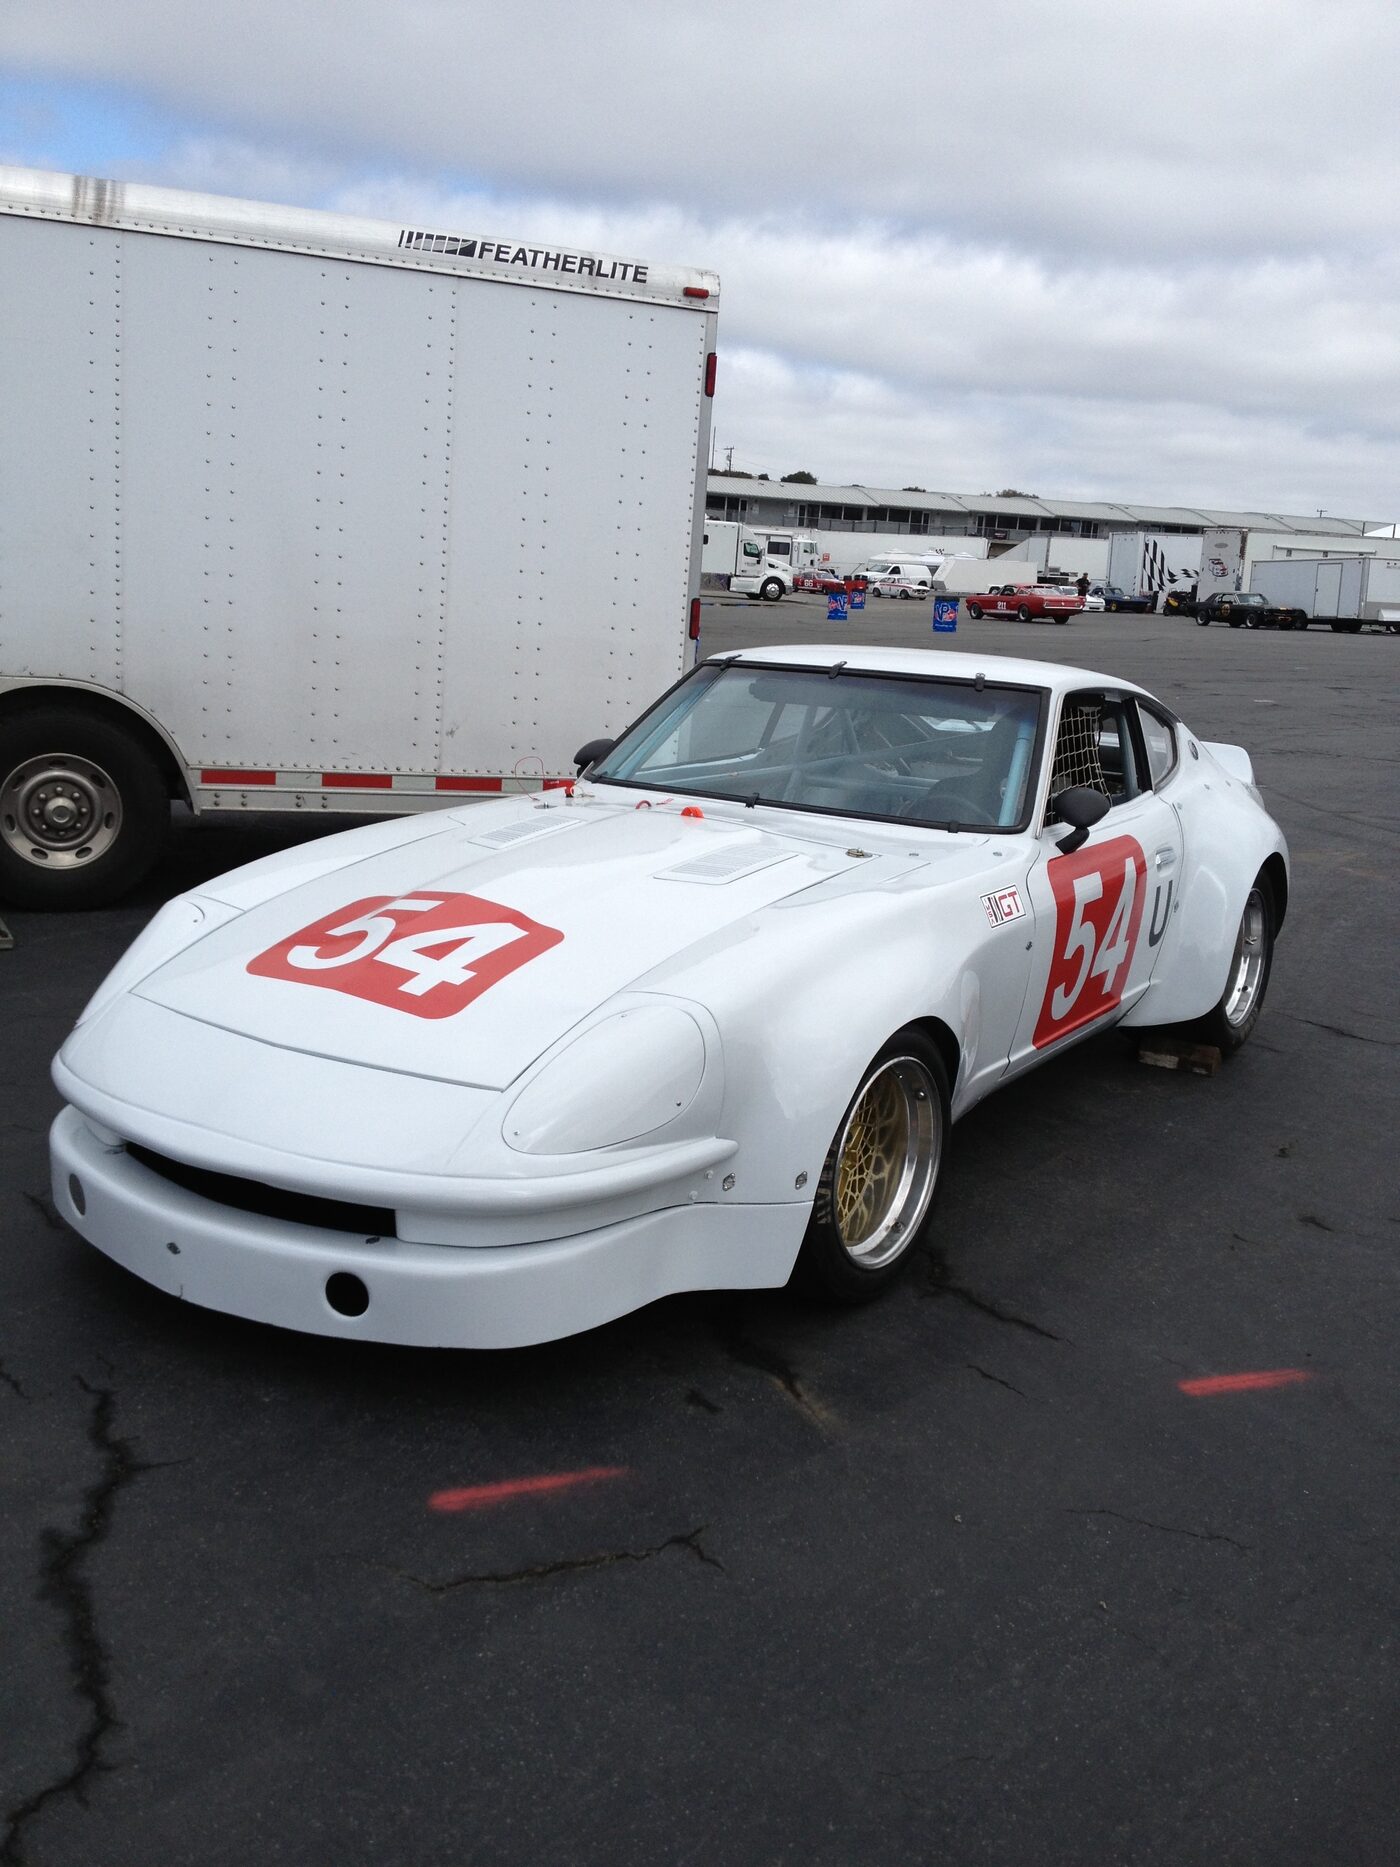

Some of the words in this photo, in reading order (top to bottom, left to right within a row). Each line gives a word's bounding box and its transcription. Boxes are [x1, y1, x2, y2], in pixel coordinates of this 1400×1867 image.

[478, 242, 649, 284] FEATHERLITE
[935, 602, 950, 622] VP
[998, 891, 1020, 917] GT
[1148, 880, 1173, 947] U
[286, 899, 530, 997] 54
[1051, 856, 1137, 1021] 54
